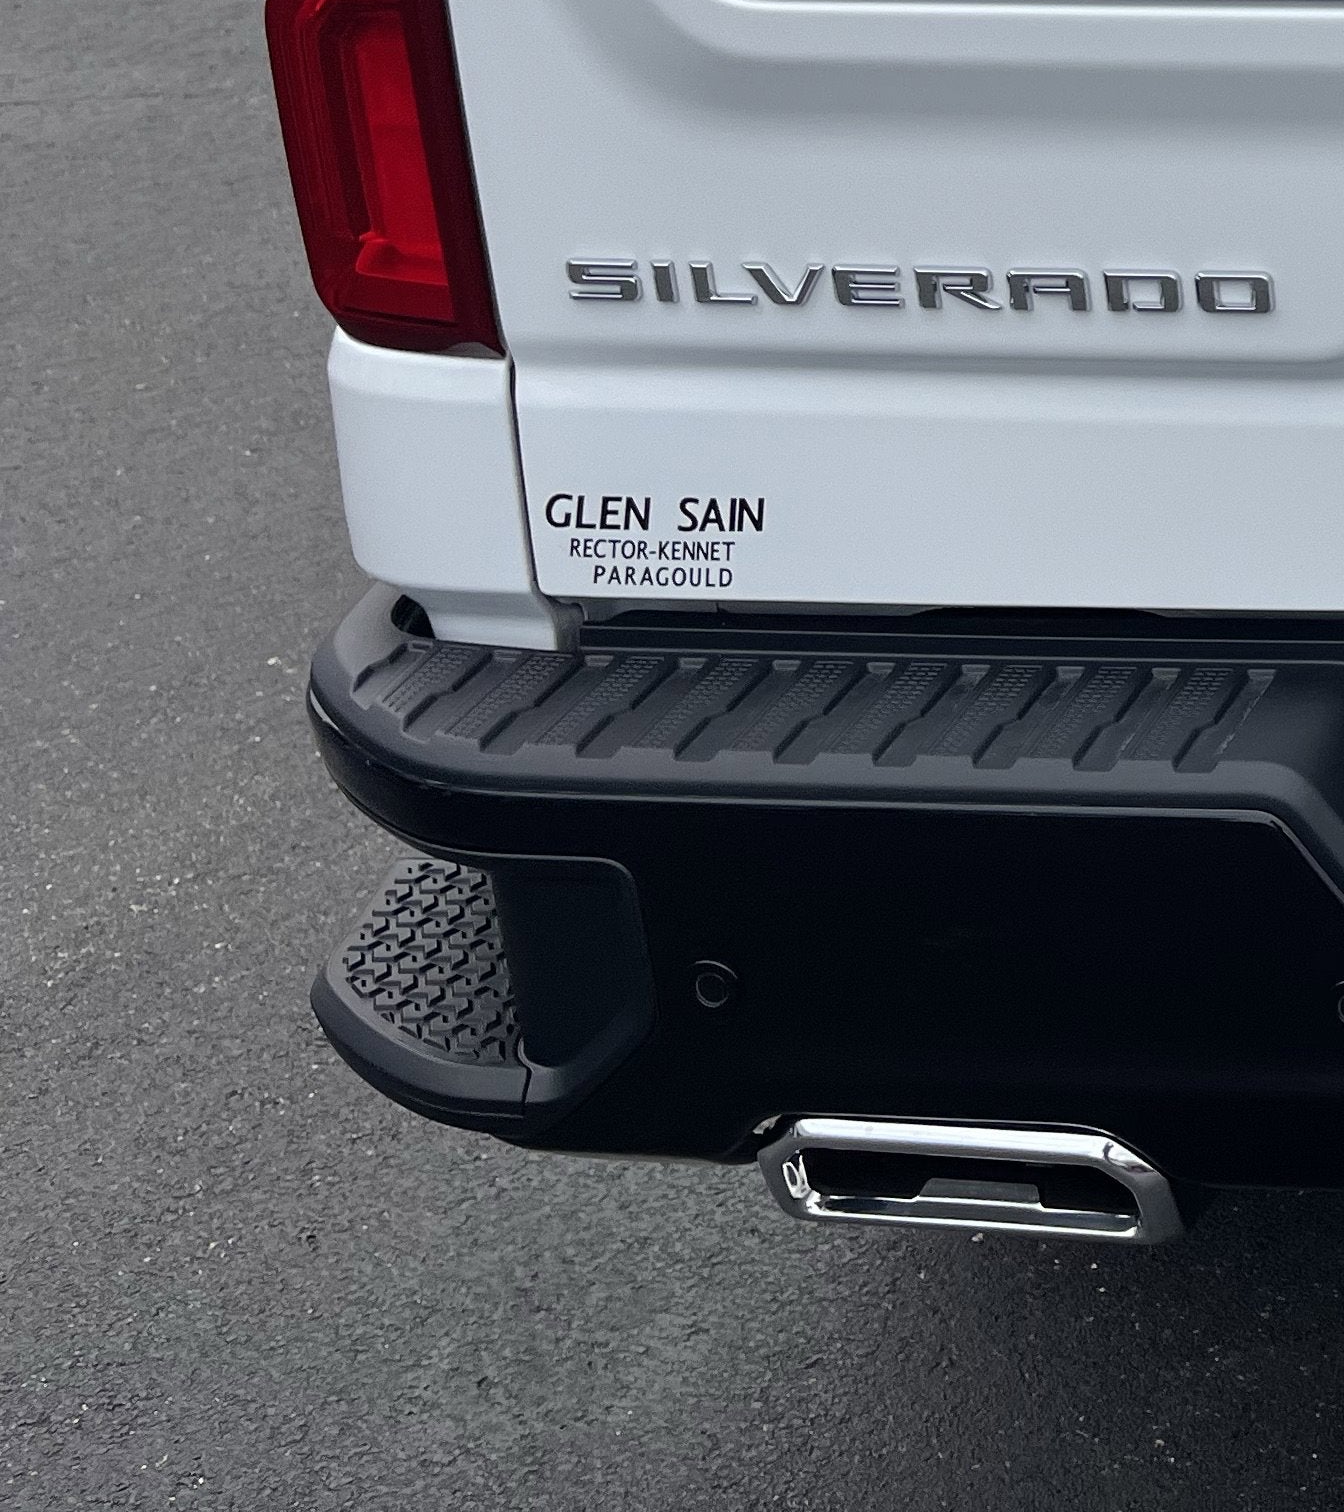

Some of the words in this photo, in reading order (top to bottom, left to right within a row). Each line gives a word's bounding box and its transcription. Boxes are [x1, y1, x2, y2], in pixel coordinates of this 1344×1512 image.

[566, 257, 1277, 313] SILVERADO
[545, 493, 651, 531] GLEN
[677, 497, 765, 532] SAIN
[569, 538, 736, 562] RECTOR-KENNET
[593, 565, 734, 588] PARAGOULD
